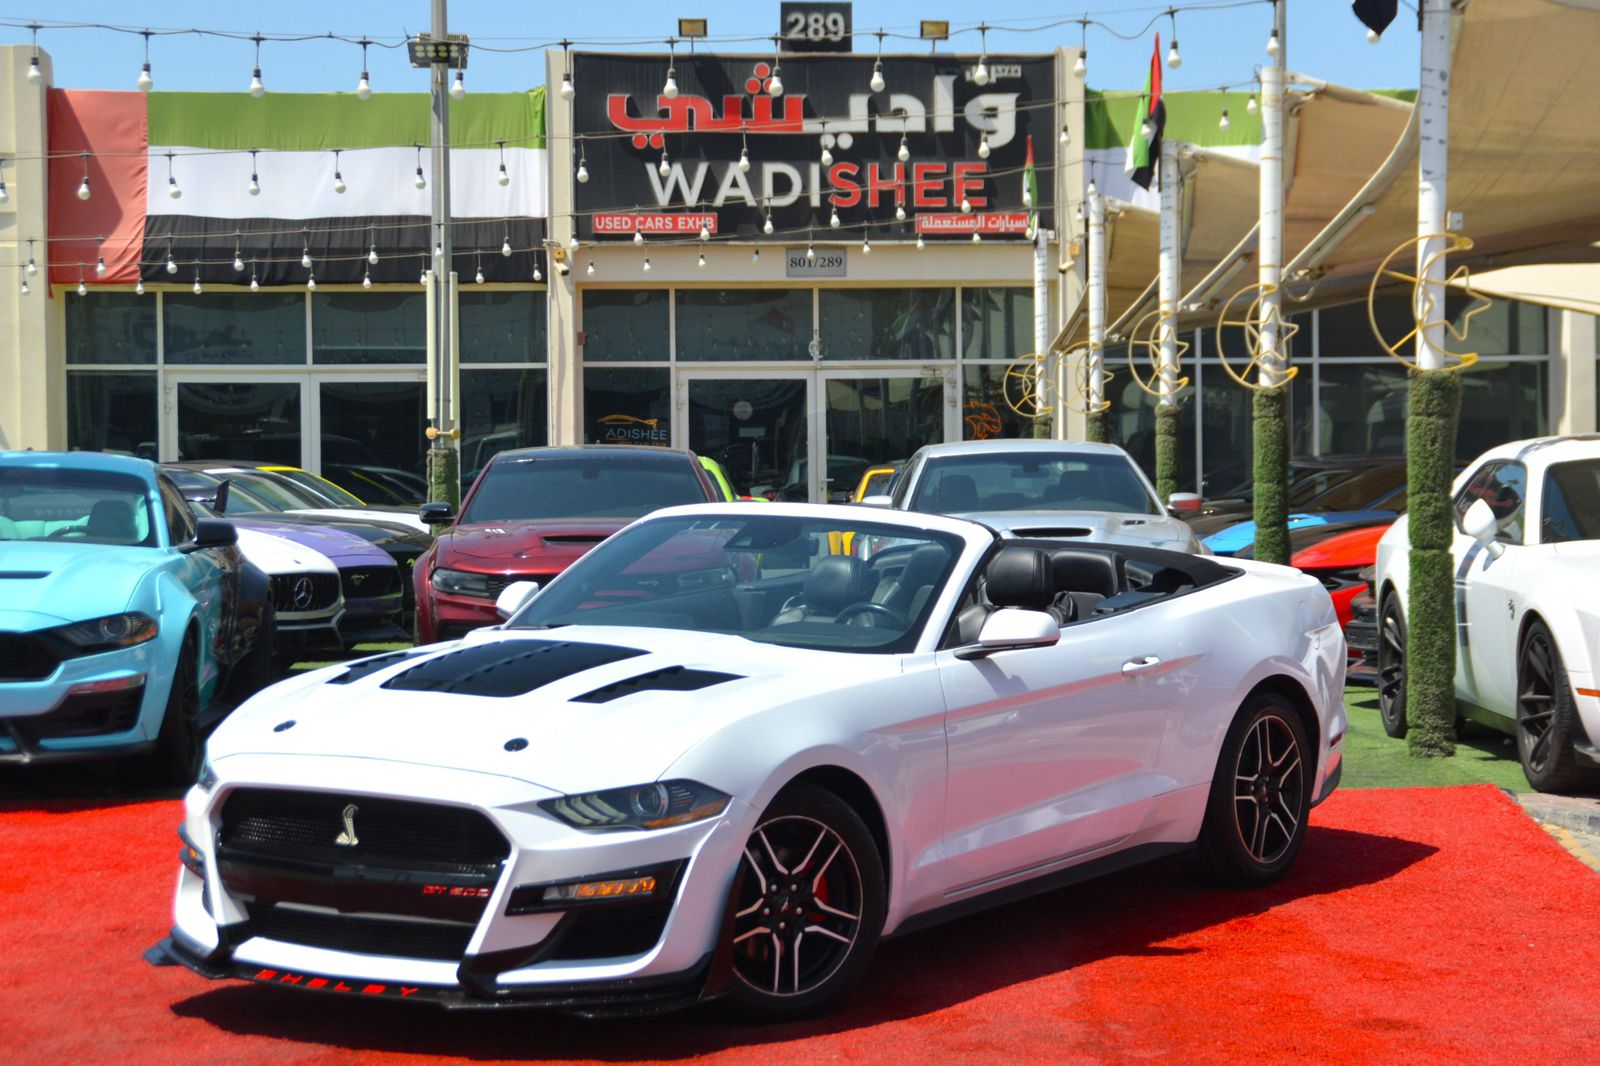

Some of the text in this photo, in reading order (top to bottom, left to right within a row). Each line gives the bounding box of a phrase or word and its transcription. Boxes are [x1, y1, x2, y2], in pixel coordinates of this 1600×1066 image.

[786, 12, 846, 42] 289
[595, 216, 632, 230] USED
[635, 216, 673, 230] CARS
[789, 256, 844, 269] 801/289
[255, 968, 420, 997] SHELBY
